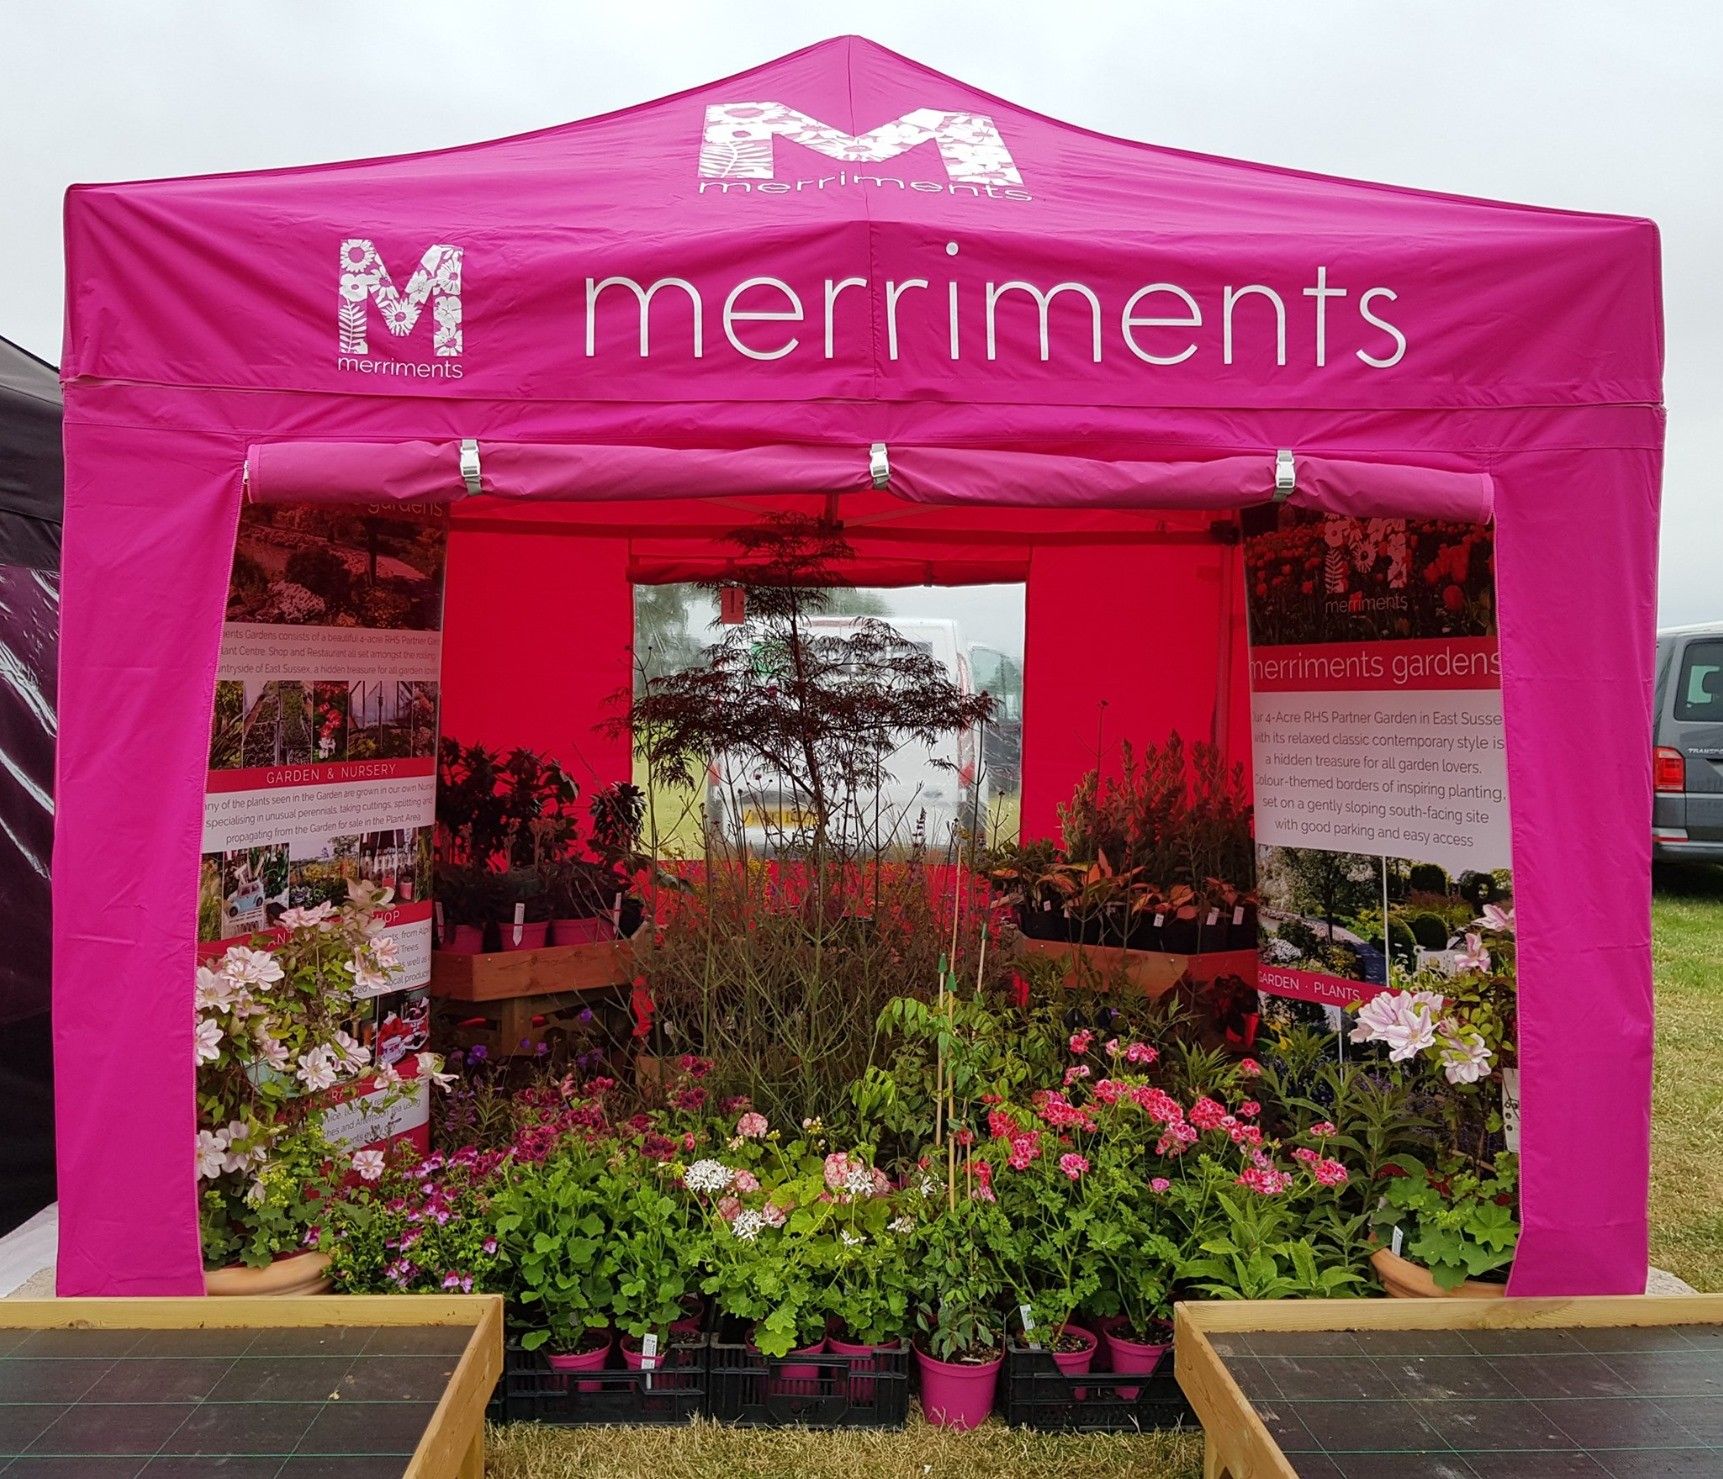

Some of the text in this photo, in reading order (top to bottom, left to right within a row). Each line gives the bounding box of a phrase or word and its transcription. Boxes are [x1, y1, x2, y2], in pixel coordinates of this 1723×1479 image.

[697, 101, 1025, 187] M
[698, 171, 1034, 202] merriments
[338, 238, 465, 358] M
[585, 241, 1407, 369] merriments
[337, 357, 464, 379] merriments
[1325, 593, 1409, 613] merriments
[246, 630, 277, 641] Gardens
[279, 632, 310, 641] consists
[312, 632, 320, 641] of
[401, 636, 426, 645] Partner
[268, 647, 289, 658] Shop
[291, 648, 305, 657] and
[307, 648, 347, 659] Restaurant
[1249, 645, 1501, 685] merriments gardens
[255, 664, 264, 673] of
[265, 664, 281, 674] East
[321, 665, 345, 675] hidden
[346, 666, 376, 675] treasure
[377, 666, 388, 675] for
[1264, 711, 1301, 724] 4-Acre
[1304, 710, 1330, 724] RHS
[1332, 711, 1371, 724] Partner
[1374, 710, 1417, 725] Garden
[1420, 711, 1430, 725] in
[1433, 711, 1458, 726] East
[1273, 732, 1286, 744] its
[1288, 732, 1330, 745] relaxed
[1332, 732, 1370, 746] classic
[1372, 734, 1454, 752] contemporary
[1457, 736, 1489, 752] style
[1493, 736, 1505, 750] is
[266, 763, 397, 784] GARDEN & NURSERY
[1265, 753, 1483, 774] a hidden treasure for all garden lovers.
[222, 799, 232, 810] of
[232, 798, 246, 810] the
[247, 797, 271, 810] plants
[272, 795, 291, 806] seen
[292, 793, 301, 803] in
[302, 792, 315, 802] the
[316, 789, 343, 801] Garden
[344, 789, 356, 798] are
[356, 787, 380, 799] grown
[380, 785, 388, 795] in
[388, 785, 401, 795] our
[402, 783, 417, 793] own
[1337, 777, 1380, 791] borders
[1382, 780, 1395, 793] of
[1397, 780, 1446, 800] inspiring
[206, 814, 256, 830] specialising
[257, 813, 265, 823] in
[266, 809, 297, 822] unusual
[340, 802, 362, 815] taking
[1262, 796, 1490, 825] set on a gently sloping south-facing site
[226, 811, 422, 846] propagating from the Garden for sale in the Plant Area
[1274, 817, 1475, 848] with good parking and easy access
[1258, 970, 1361, 1001] GARDEN PLANTS
